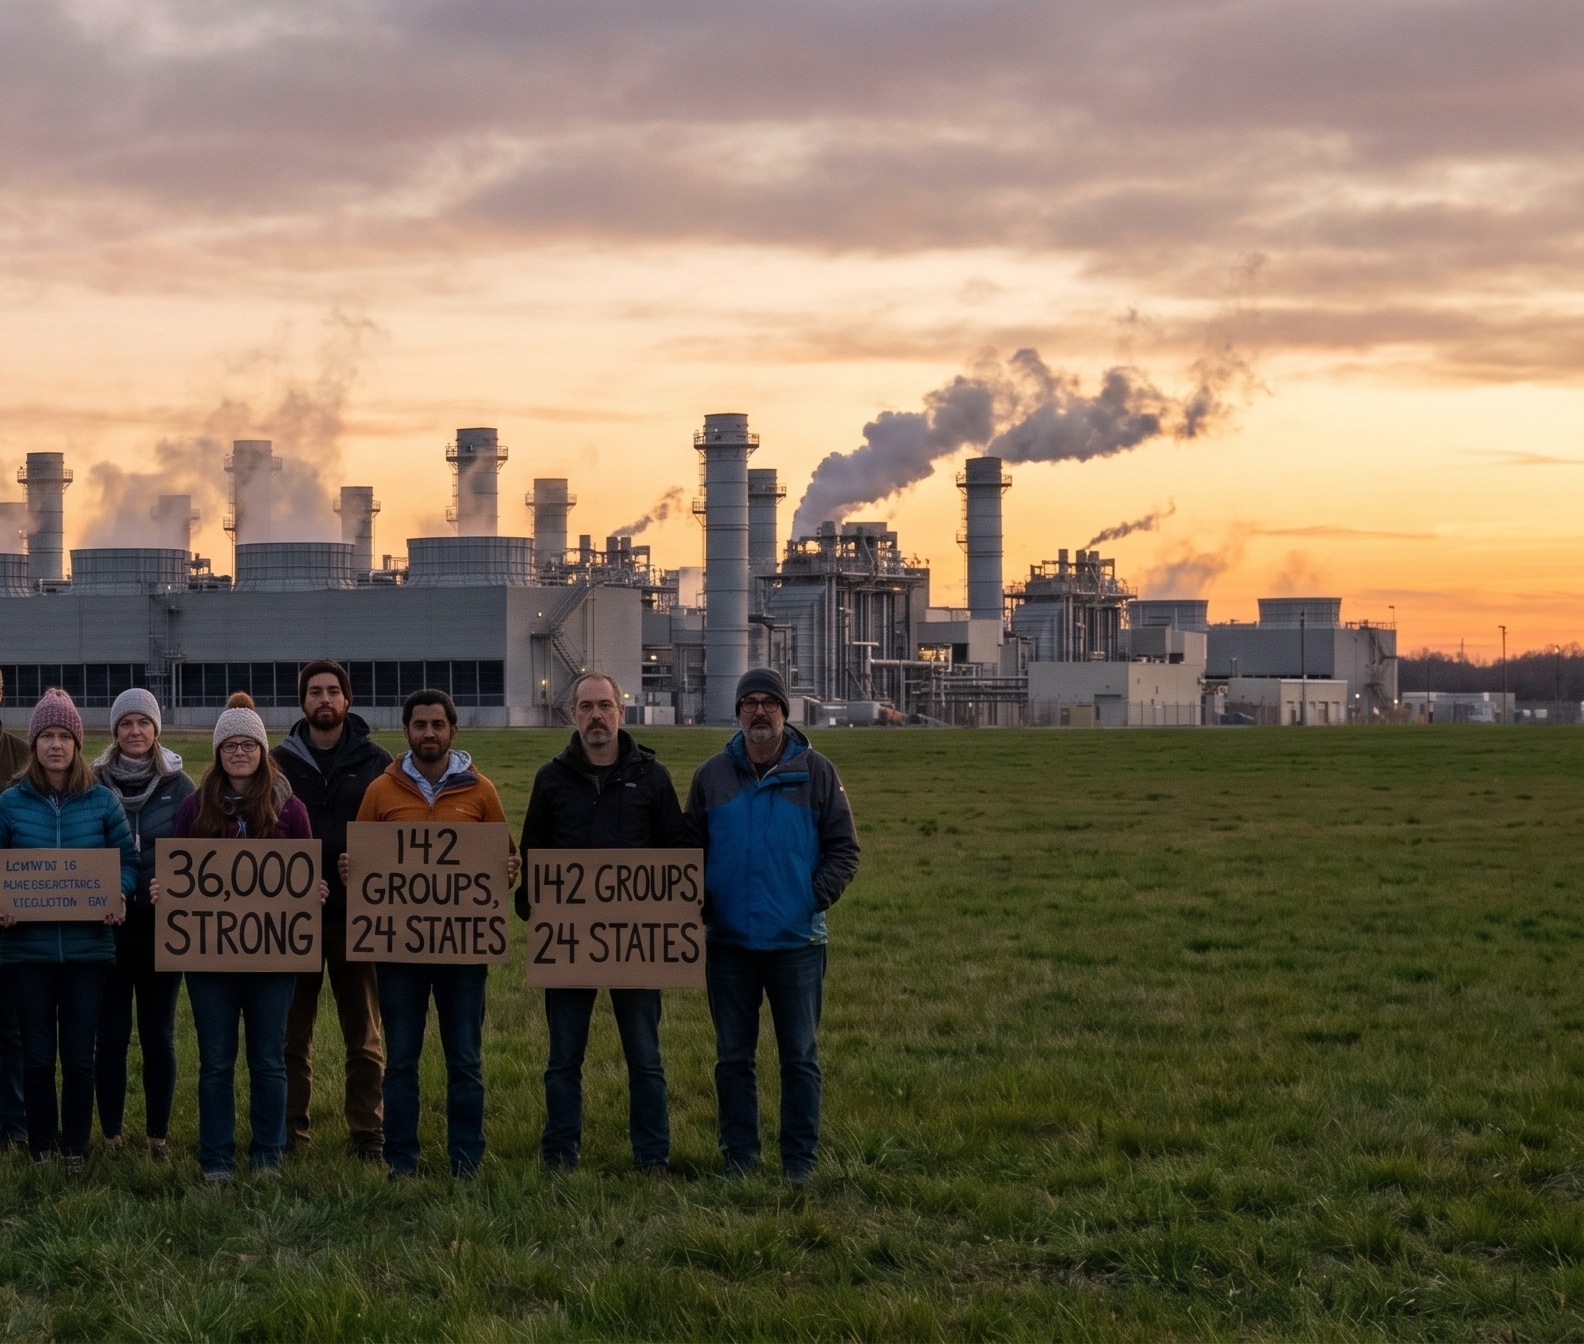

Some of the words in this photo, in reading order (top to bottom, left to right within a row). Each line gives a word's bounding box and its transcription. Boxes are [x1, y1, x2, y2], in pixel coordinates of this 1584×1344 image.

[397, 828, 461, 866] 142
[167, 849, 314, 902] 36,000
[362, 872, 499, 910] GROUPS,
[534, 863, 586, 905] 142
[164, 909, 314, 956] STRONG
[352, 914, 396, 953] 24
[405, 914, 507, 956] STATES
[534, 921, 579, 964] 24
[589, 921, 700, 964] STATES
